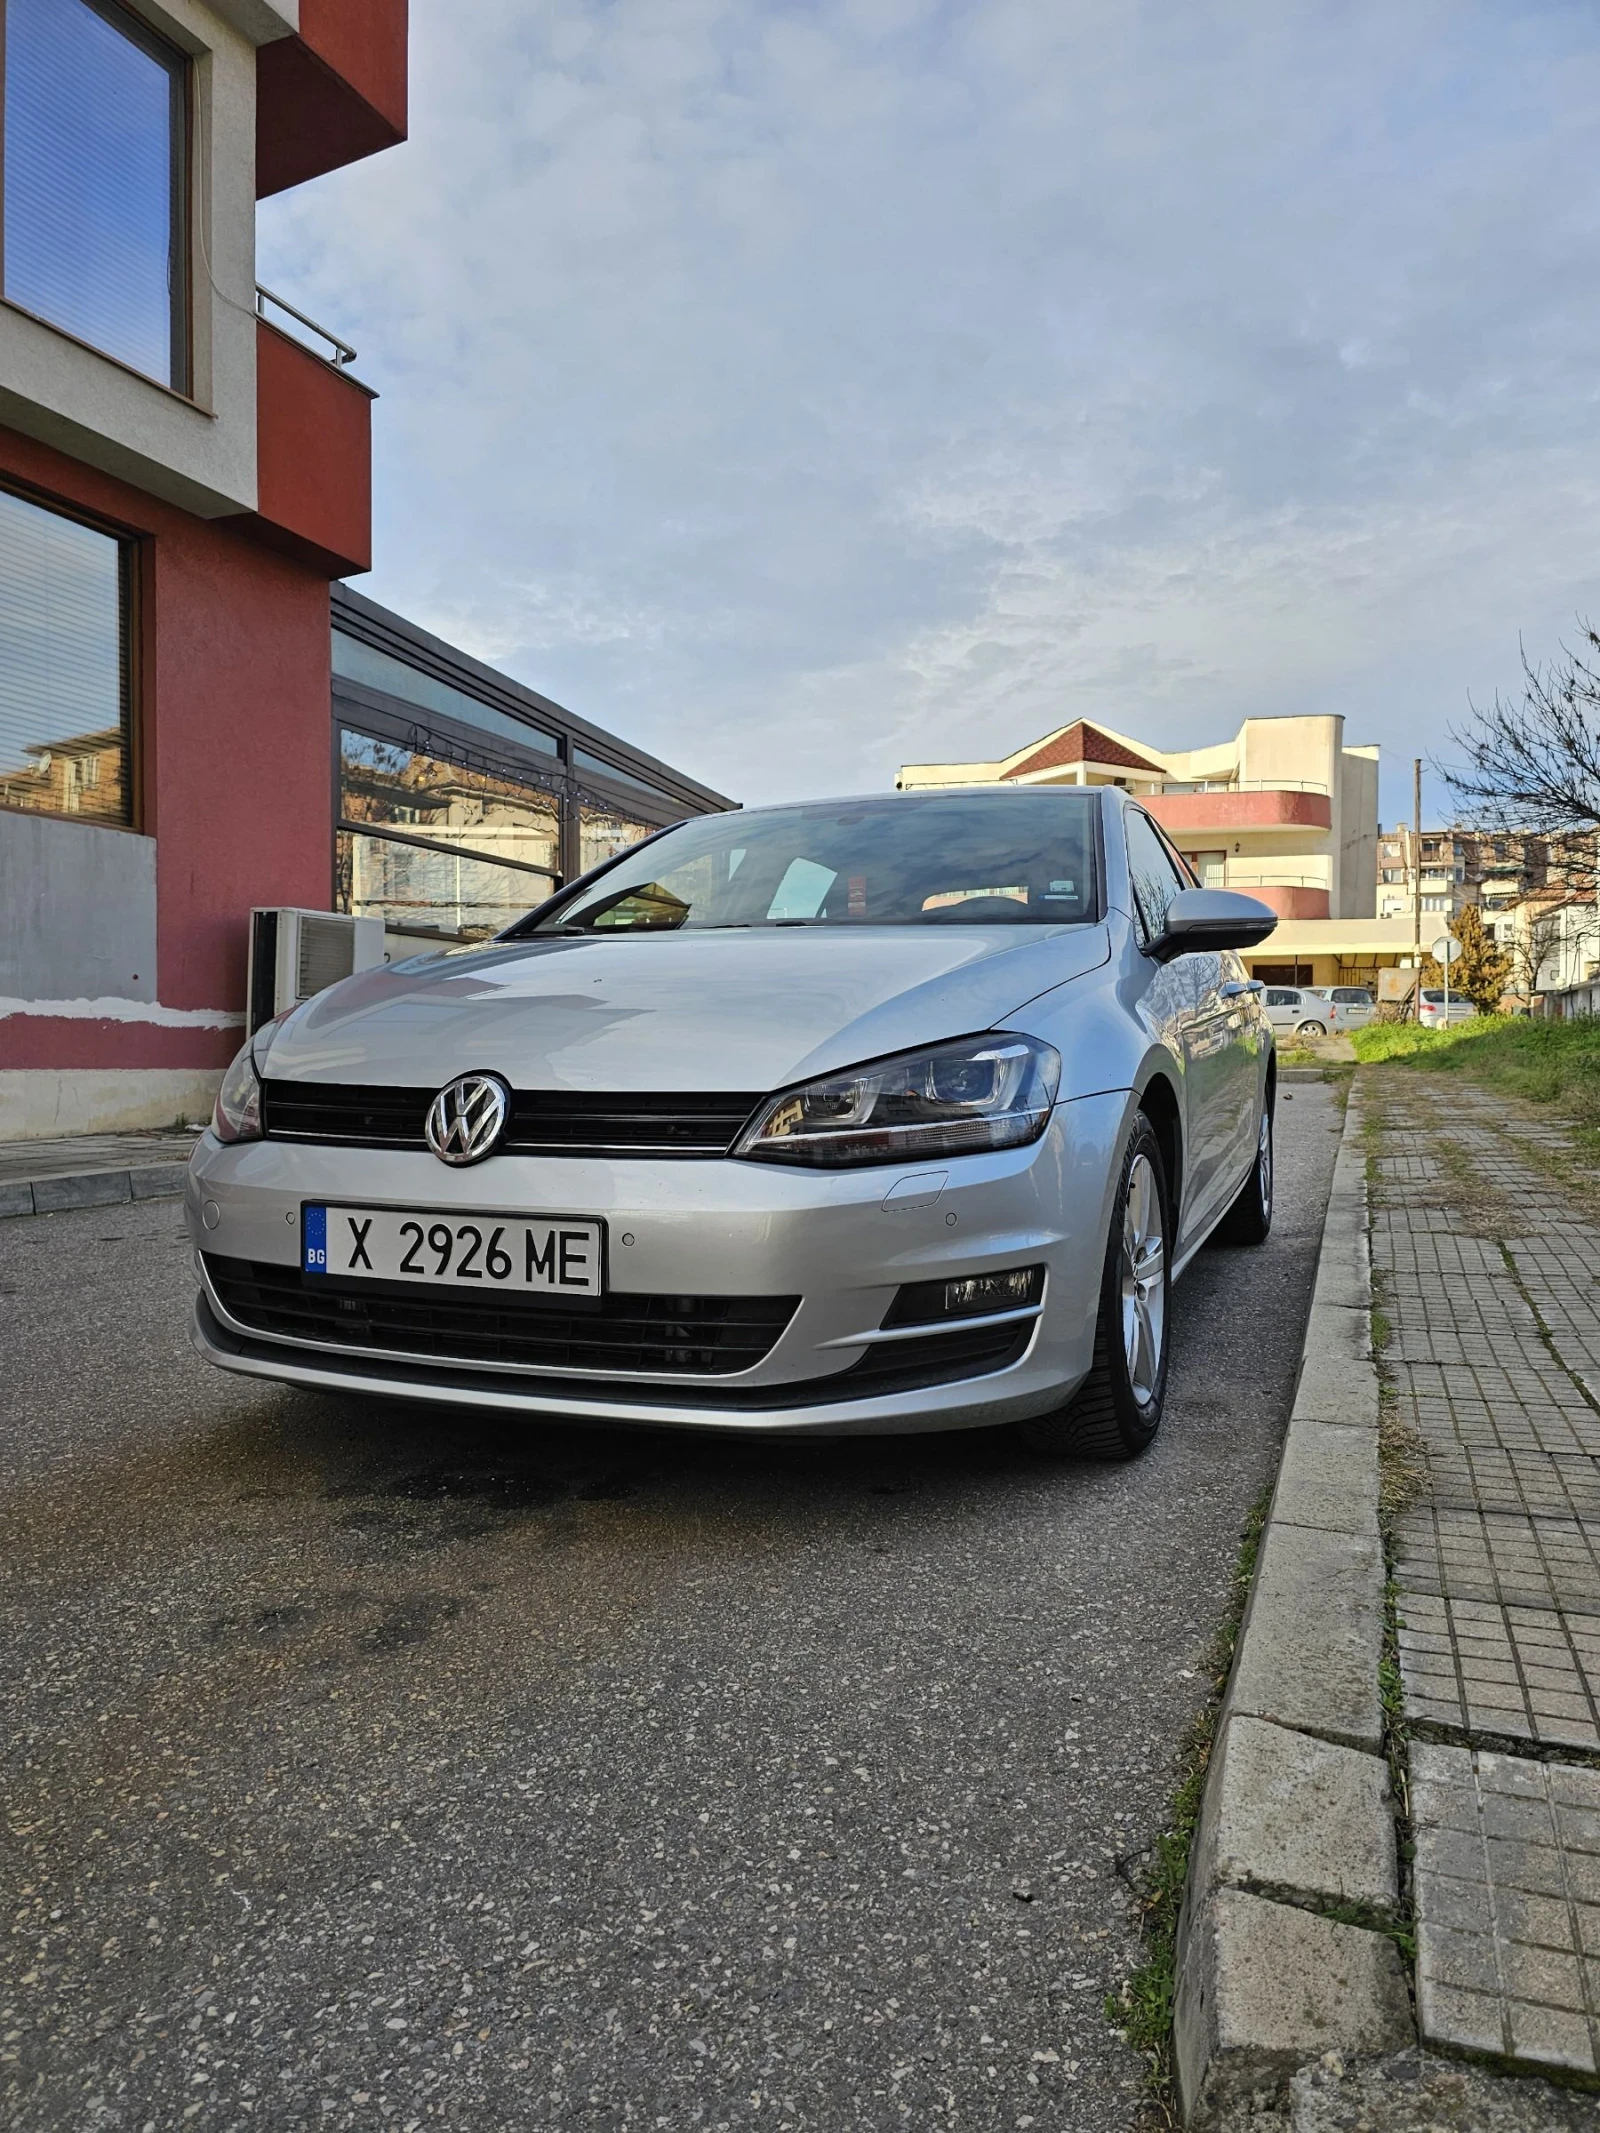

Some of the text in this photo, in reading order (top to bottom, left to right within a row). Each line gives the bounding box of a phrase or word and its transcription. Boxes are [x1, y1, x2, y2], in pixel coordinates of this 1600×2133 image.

[307, 1248, 325, 1264] BG
[347, 1217, 589, 1287] X 2926 ME
